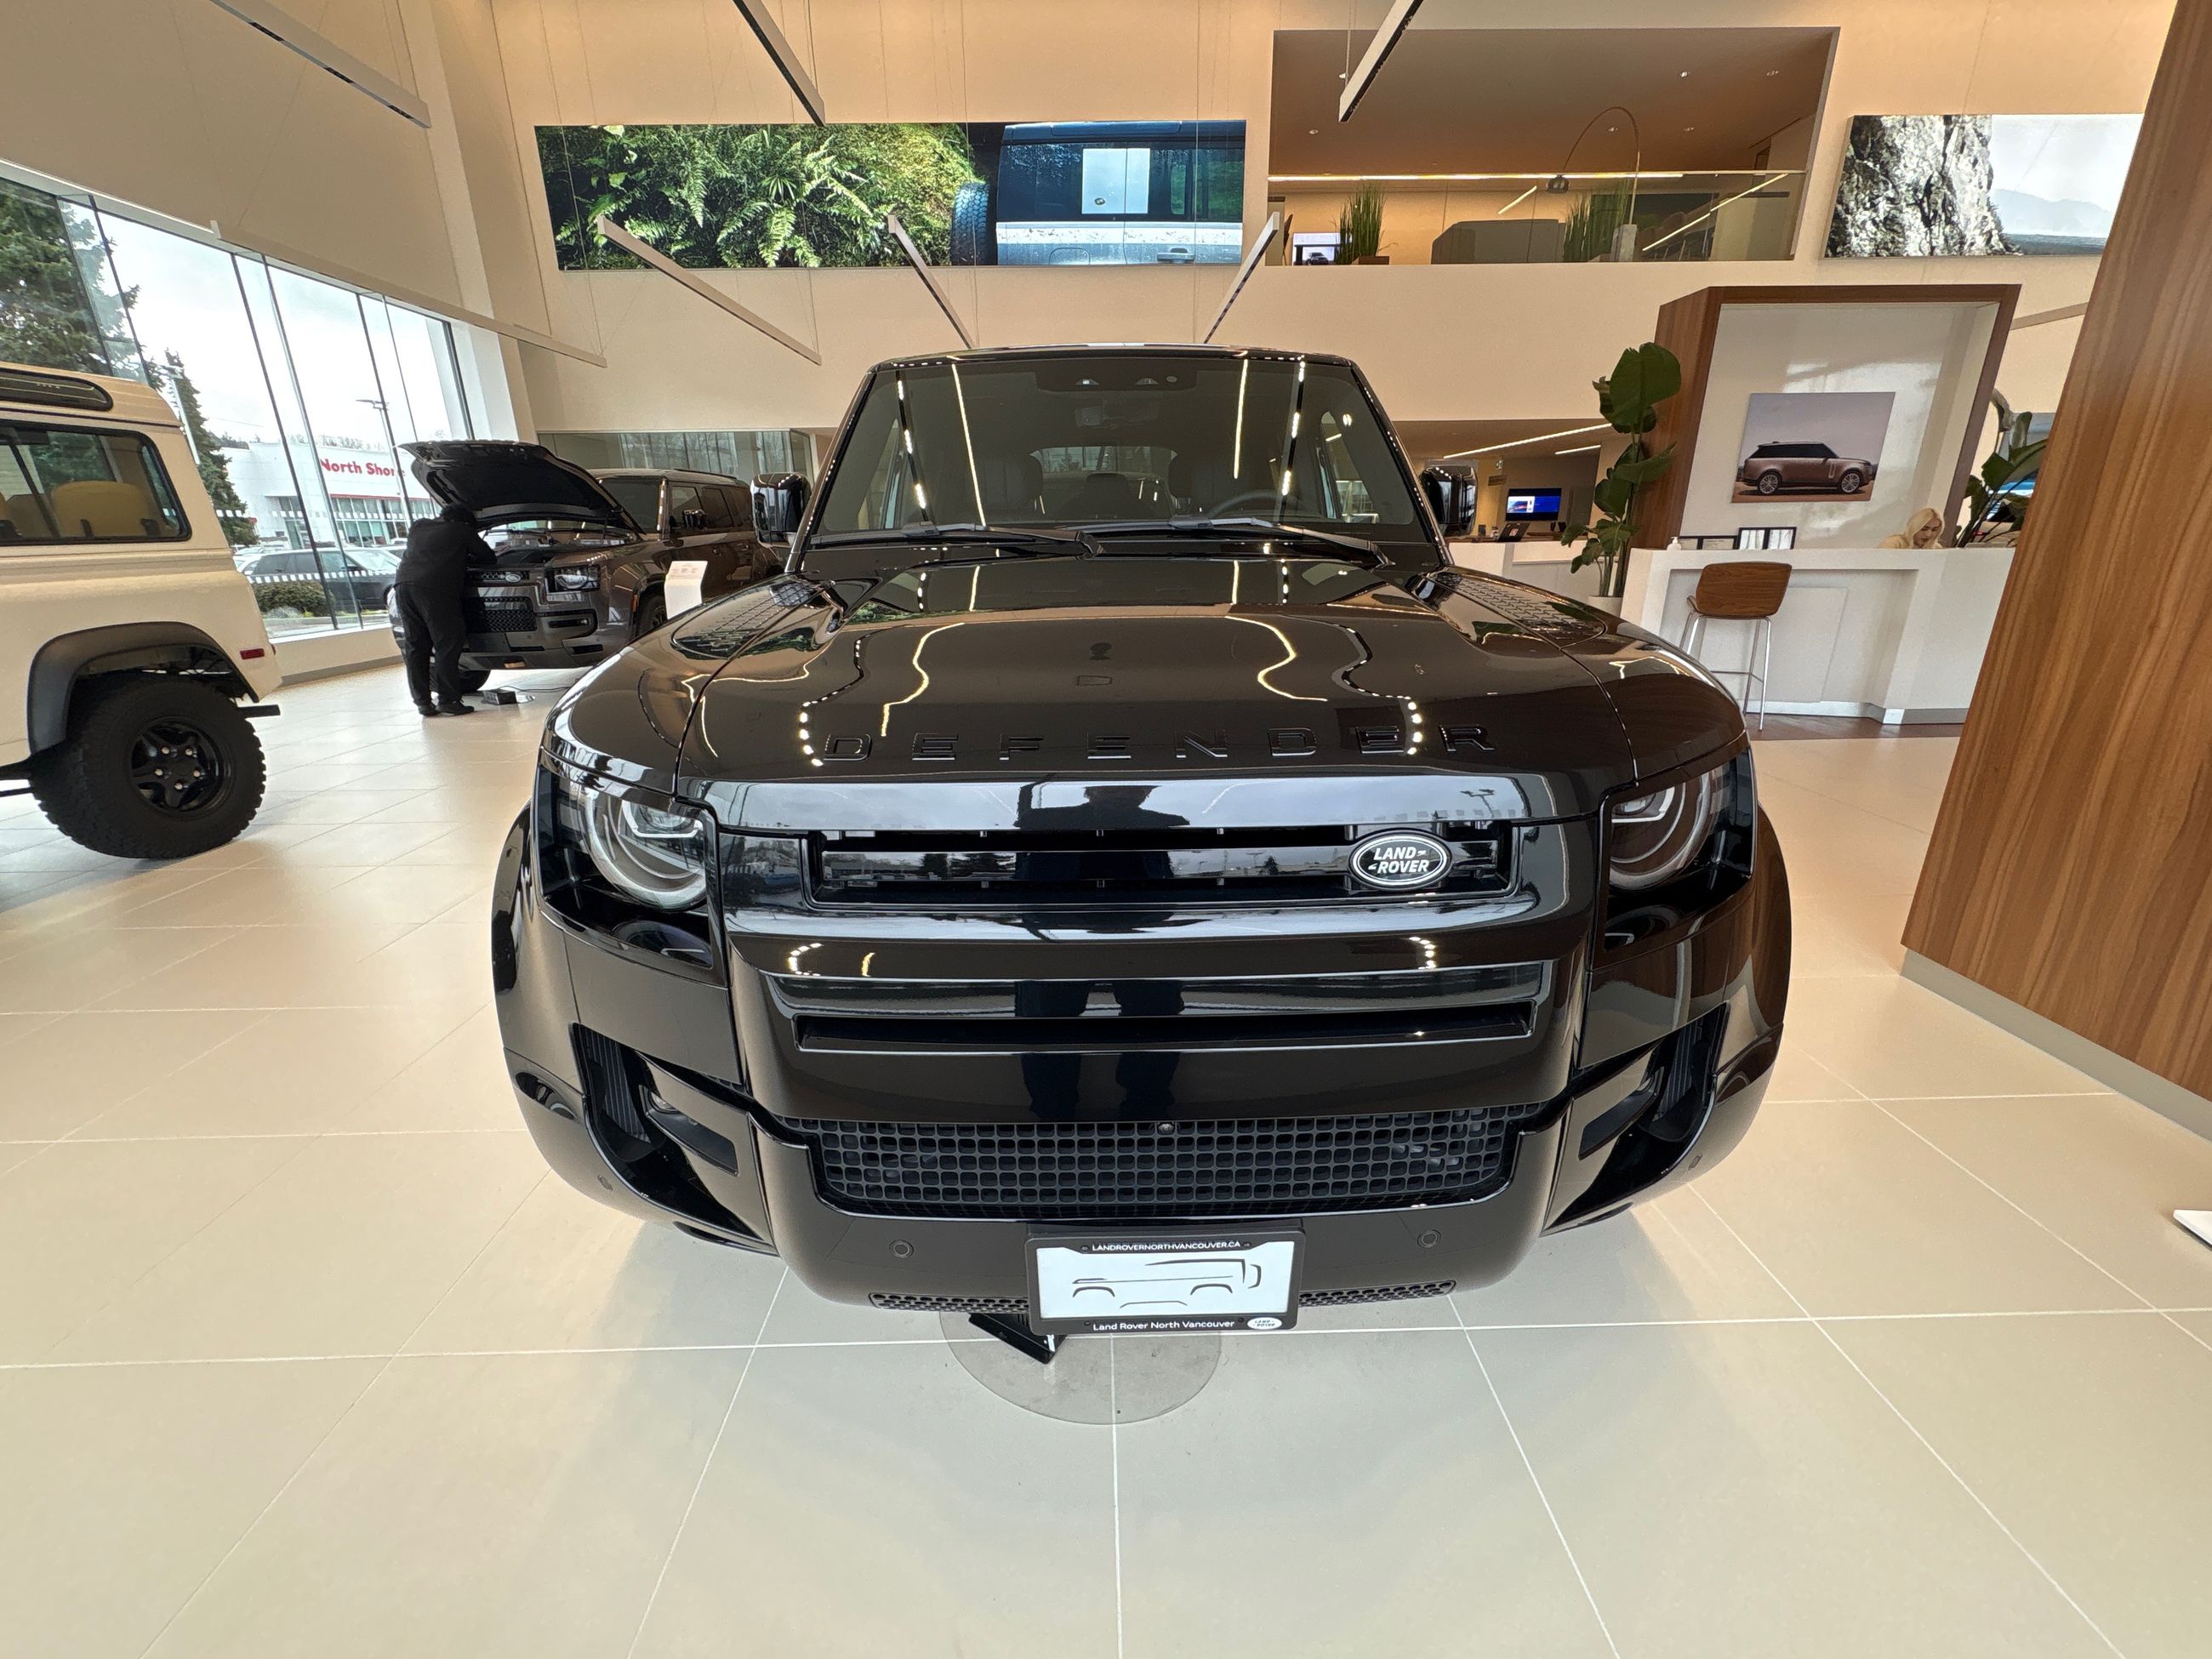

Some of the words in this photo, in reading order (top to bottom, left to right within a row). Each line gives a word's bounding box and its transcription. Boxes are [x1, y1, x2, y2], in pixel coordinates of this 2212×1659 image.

[319, 459, 362, 474] North
[823, 724, 1495, 762] DEFENDER
[1373, 847, 1416, 860] LAND
[1377, 859, 1429, 874] ROVER
[1092, 1241, 1240, 1251] LANDROVERNORTHVANCOUVER.CA
[1093, 1322, 1118, 1331] Land
